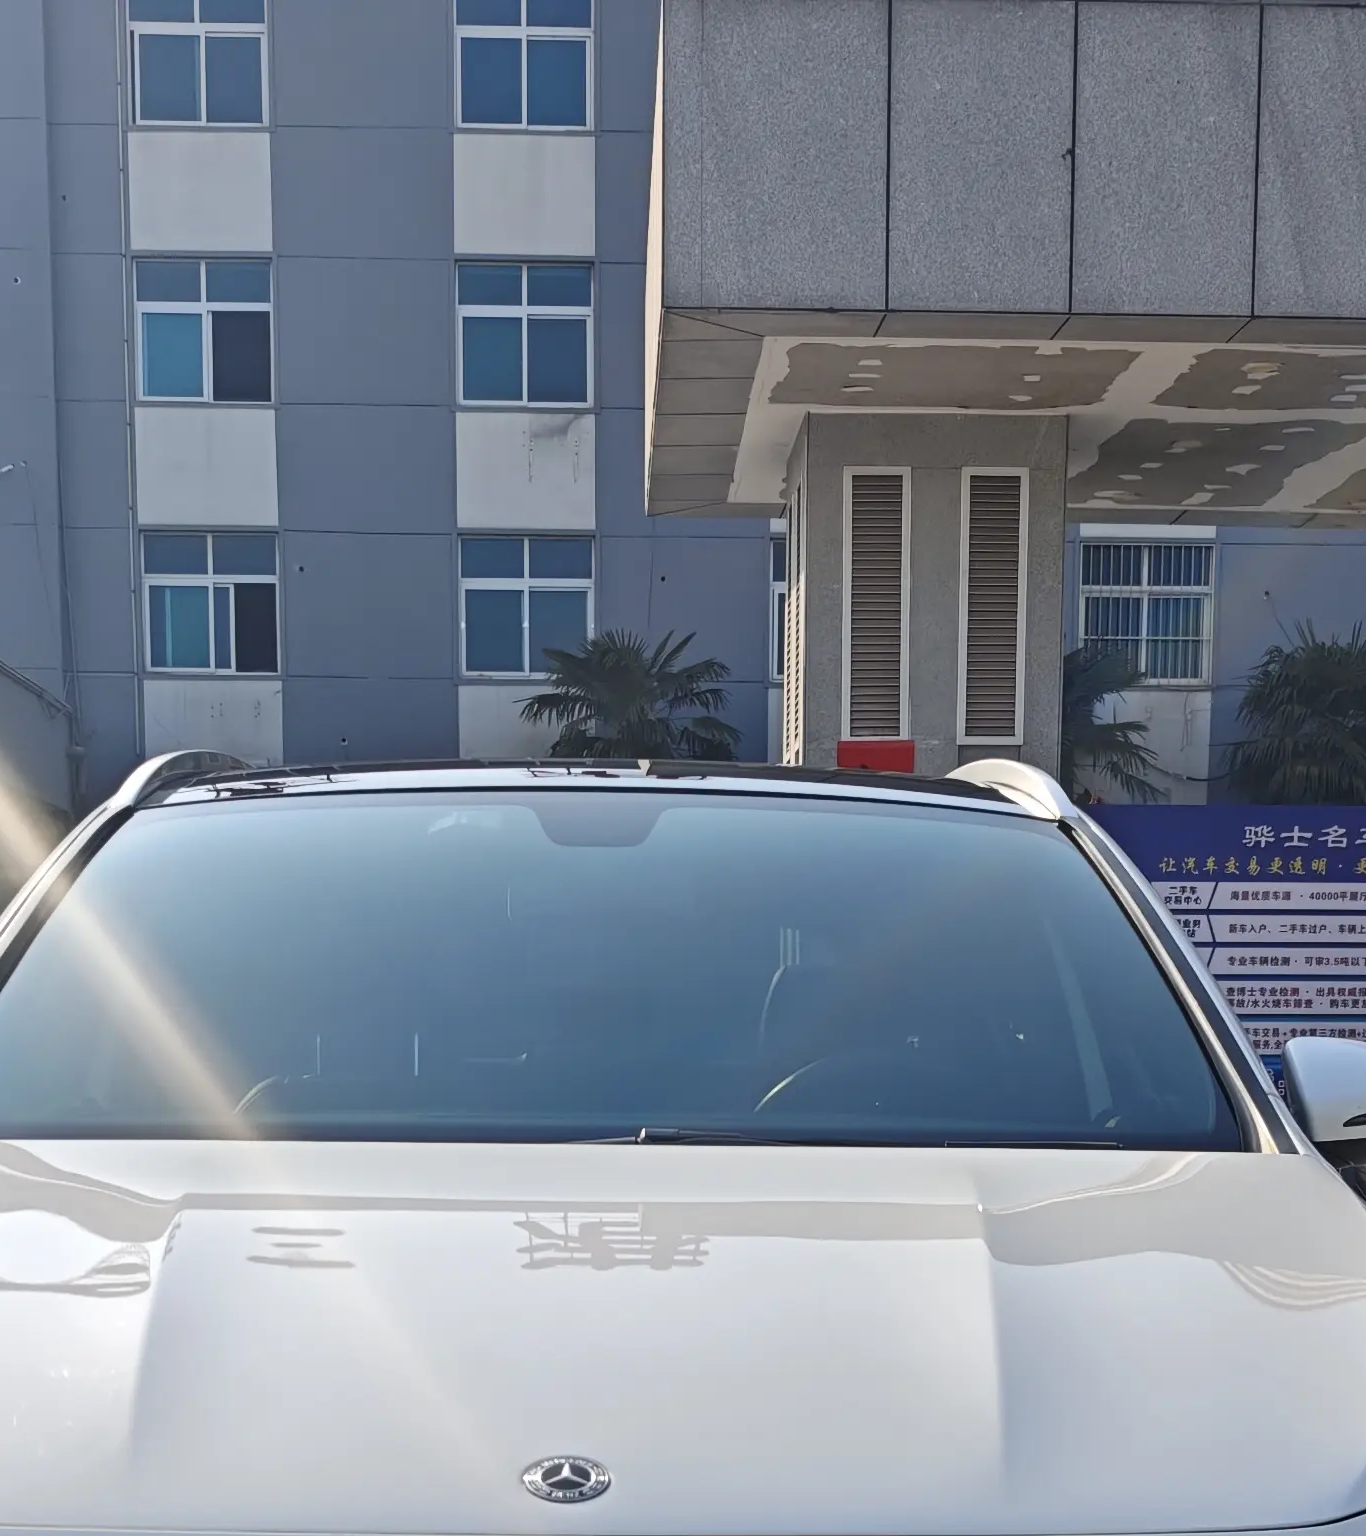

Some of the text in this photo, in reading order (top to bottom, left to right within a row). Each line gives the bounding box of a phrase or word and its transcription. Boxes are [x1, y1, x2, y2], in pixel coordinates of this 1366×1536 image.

[1168, 886, 1198, 895] 二手车
[1164, 896, 1203, 905] 交易中心
